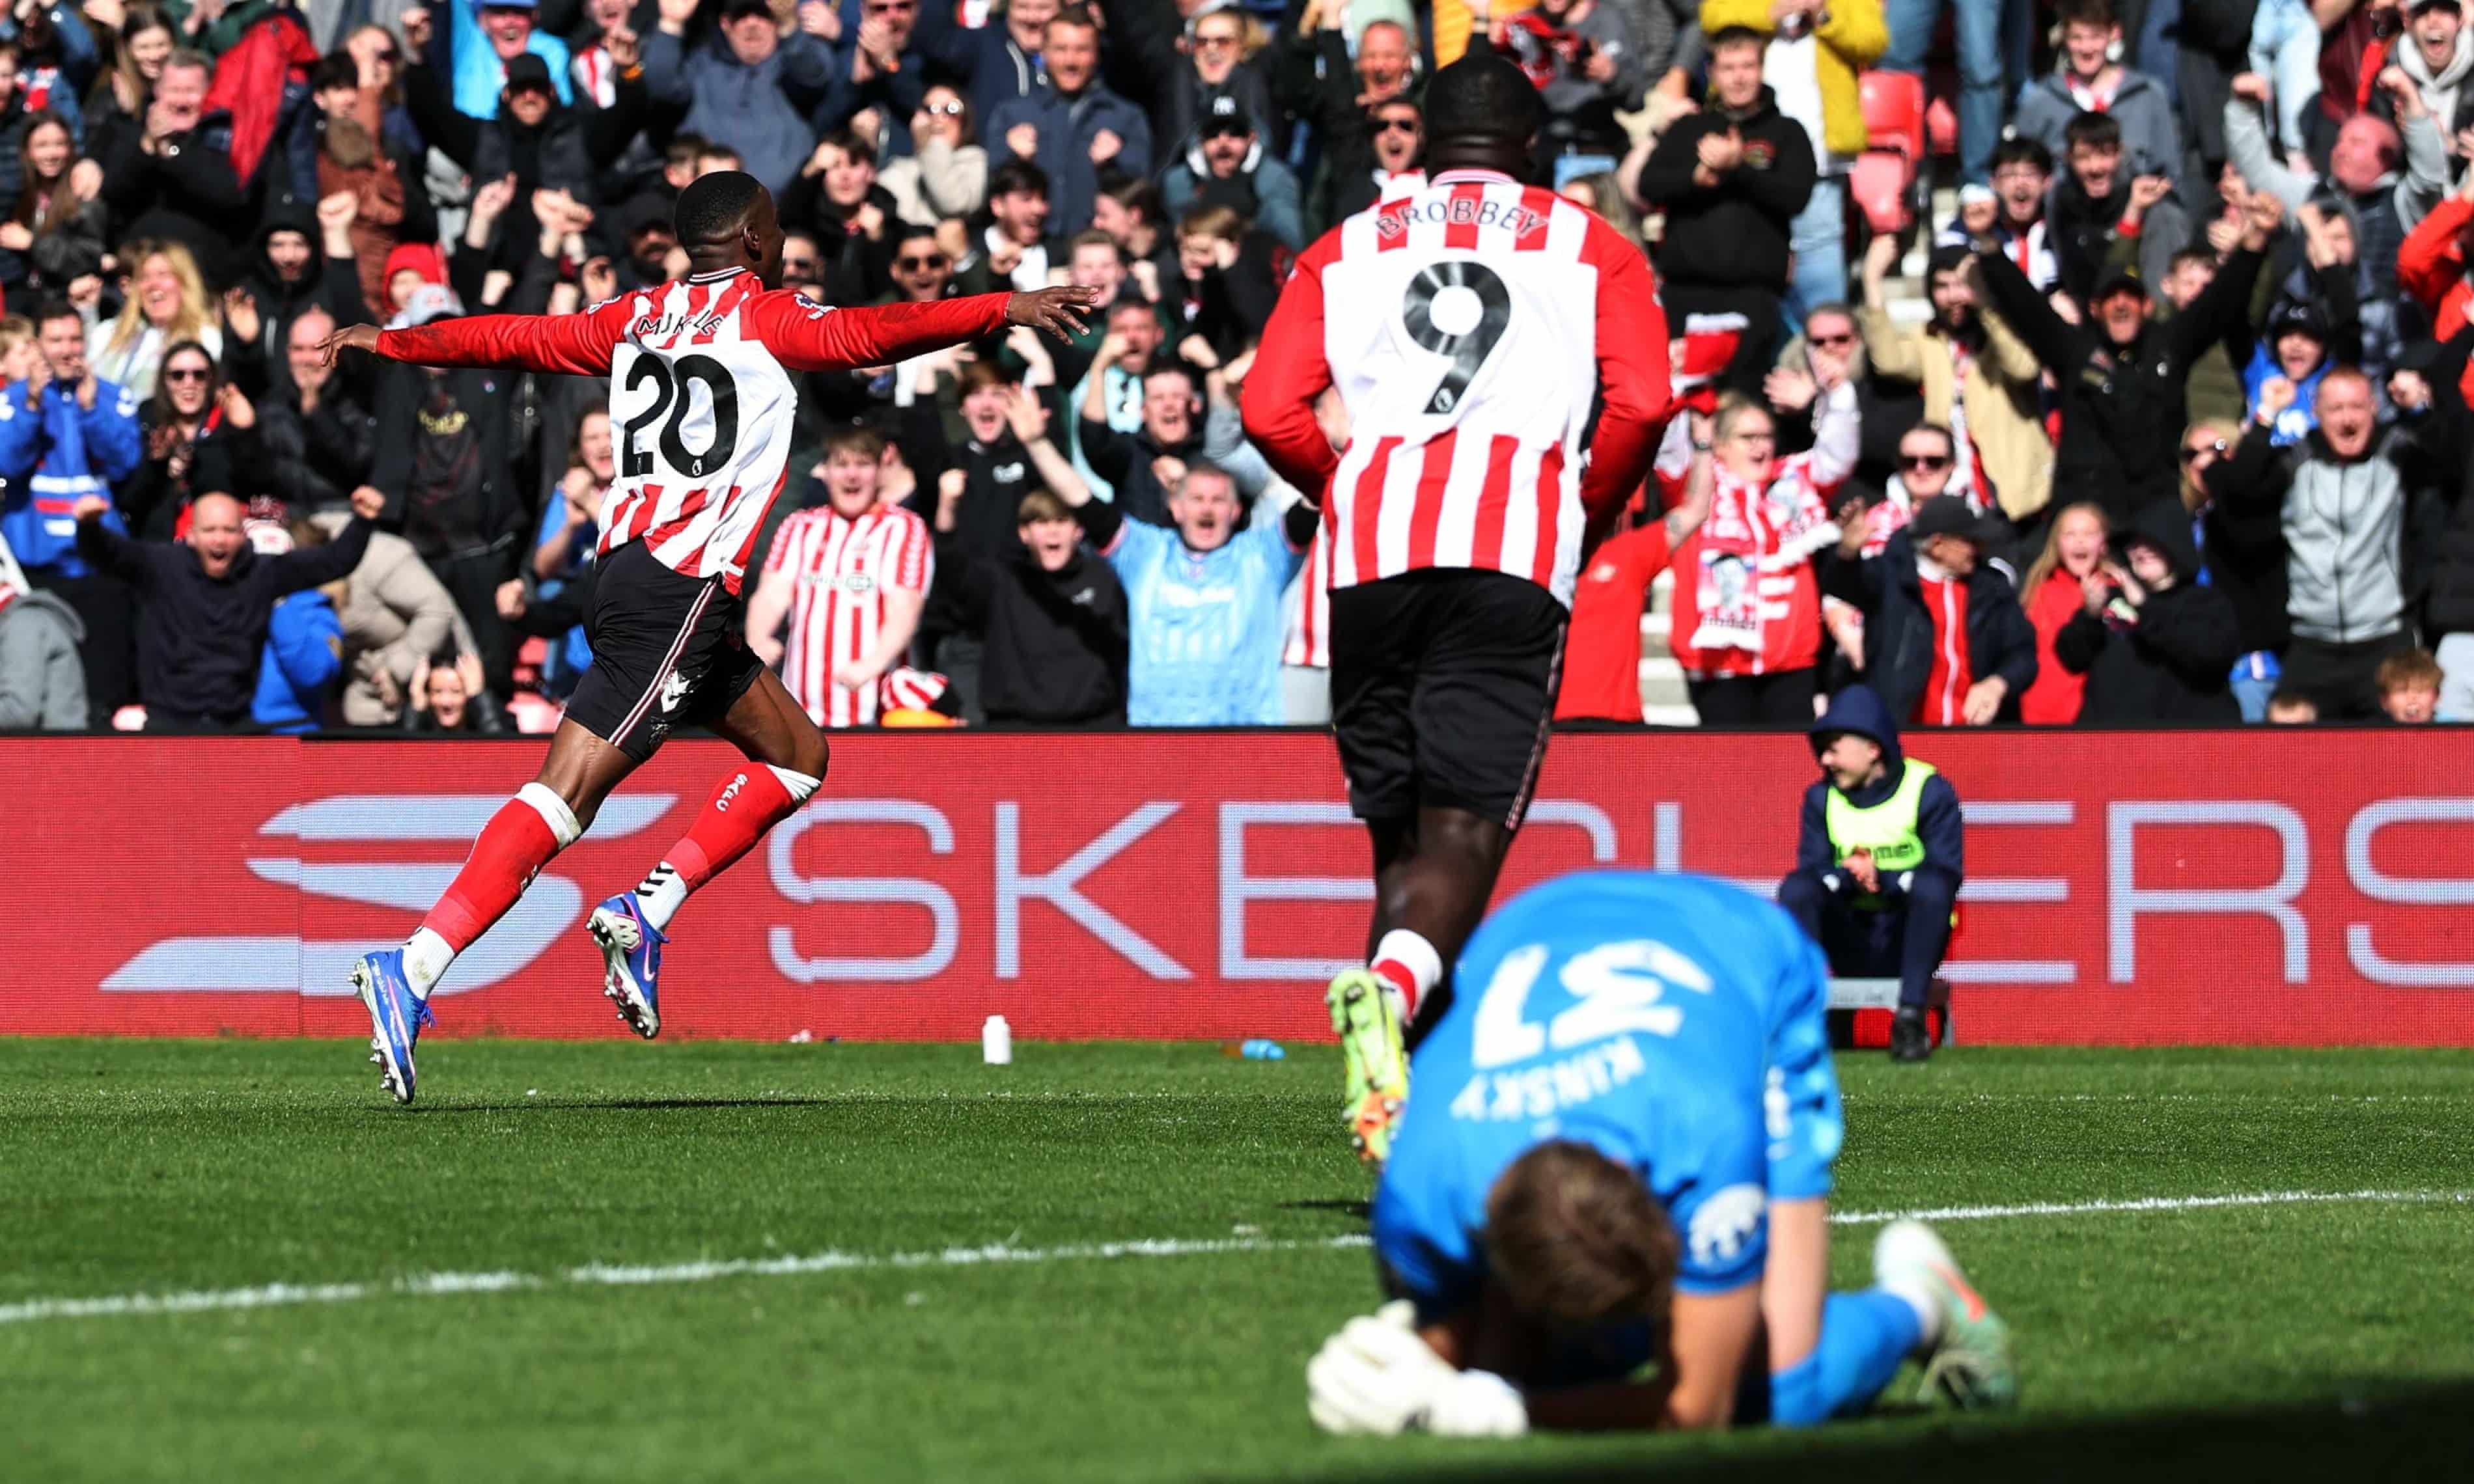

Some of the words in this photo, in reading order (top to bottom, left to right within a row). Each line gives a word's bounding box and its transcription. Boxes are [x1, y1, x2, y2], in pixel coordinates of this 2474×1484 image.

[1376, 199, 1548, 235] BROBBEY
[1402, 261, 1511, 414] 9
[622, 352, 739, 478] 20
[716, 773, 748, 812] SAFC
[768, 797, 2474, 983] SKEERS
[1471, 939, 1715, 1069] 31
[1449, 1034, 1647, 1122] KINSKY
